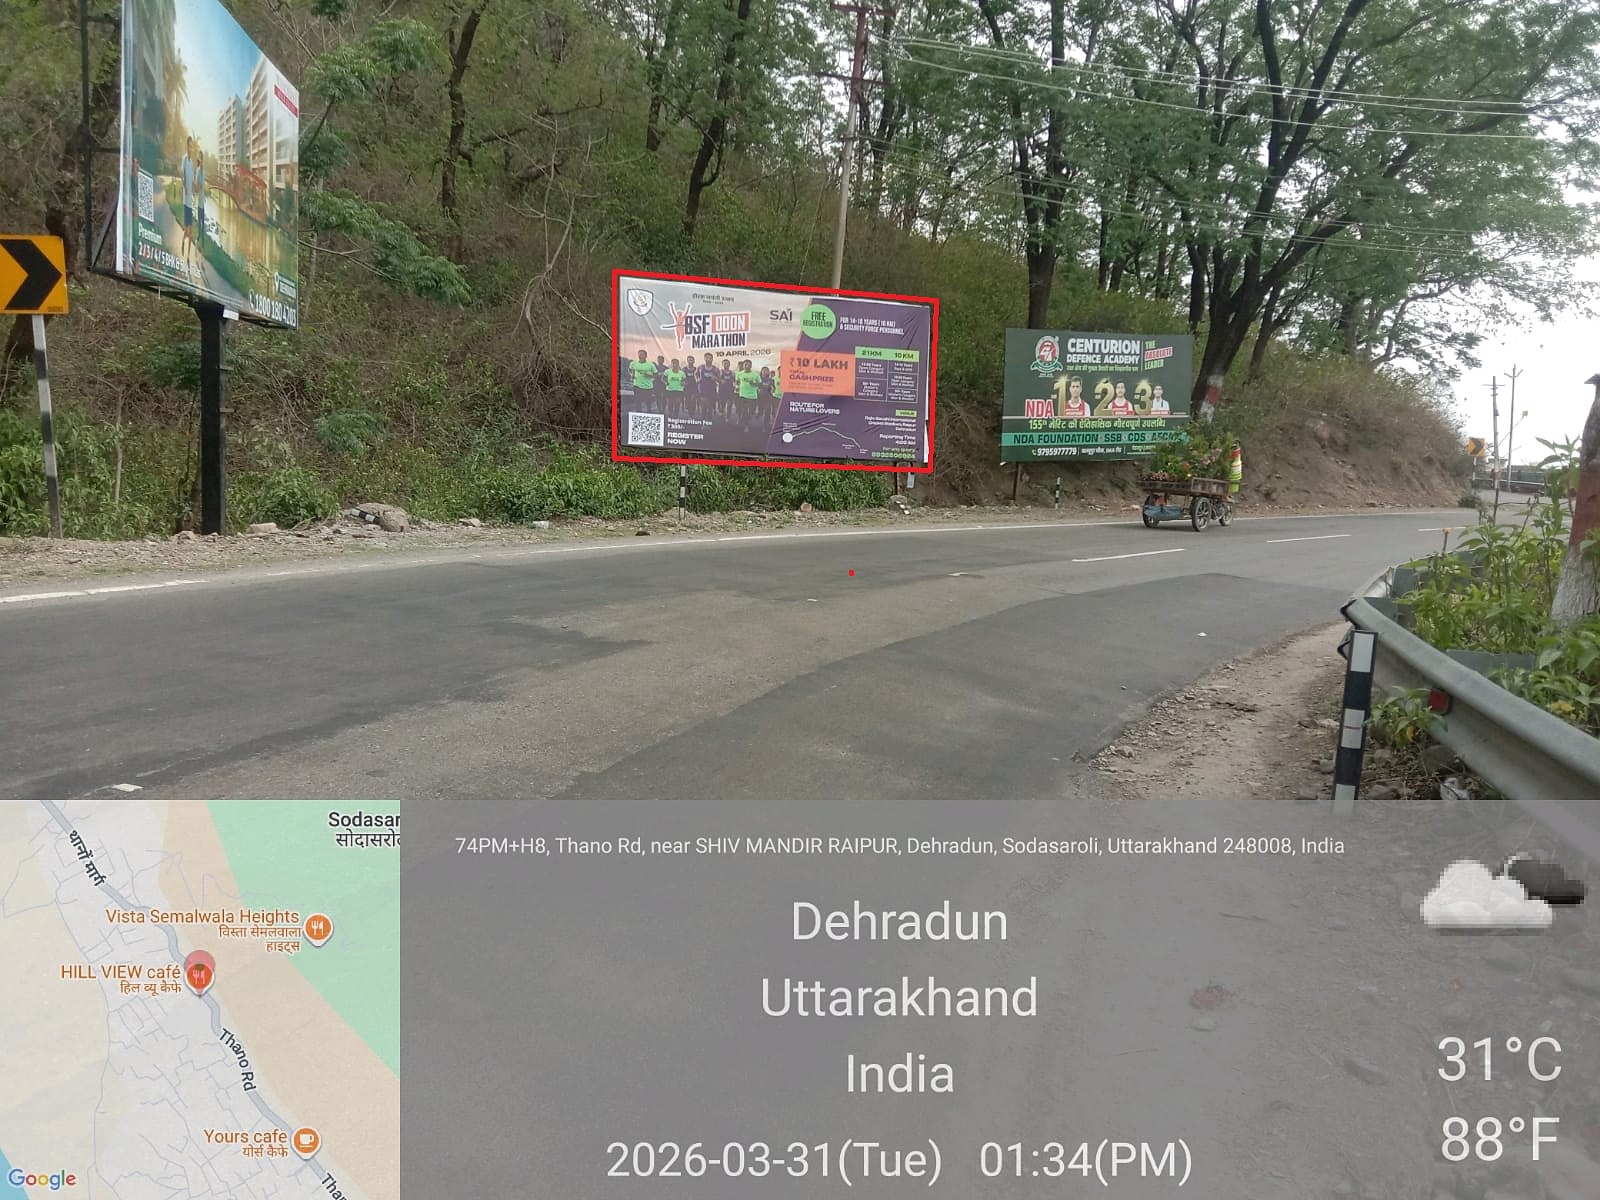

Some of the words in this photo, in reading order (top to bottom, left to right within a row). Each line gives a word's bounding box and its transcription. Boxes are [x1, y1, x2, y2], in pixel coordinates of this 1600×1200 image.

[138, 222, 162, 246] Premium
[811, 311, 827, 321] FREE
[684, 315, 711, 335] BSF
[715, 315, 746, 331] DOON
[692, 333, 746, 349] MARATHON
[1067, 338, 1141, 355] CENTURION
[750, 348, 772, 356] 2026
[1066, 353, 1102, 363] DEFENCE
[1103, 354, 1140, 364] ACADEMY
[813, 359, 849, 370] LAKH
[1025, 398, 1055, 418] NDA
[667, 431, 705, 440] REGISTER
[1013, 433, 1035, 445] NDA
[1037, 432, 1099, 445] FOUNDATION
[1104, 432, 1122, 443] SSB
[1127, 431, 1146, 442] CDS
